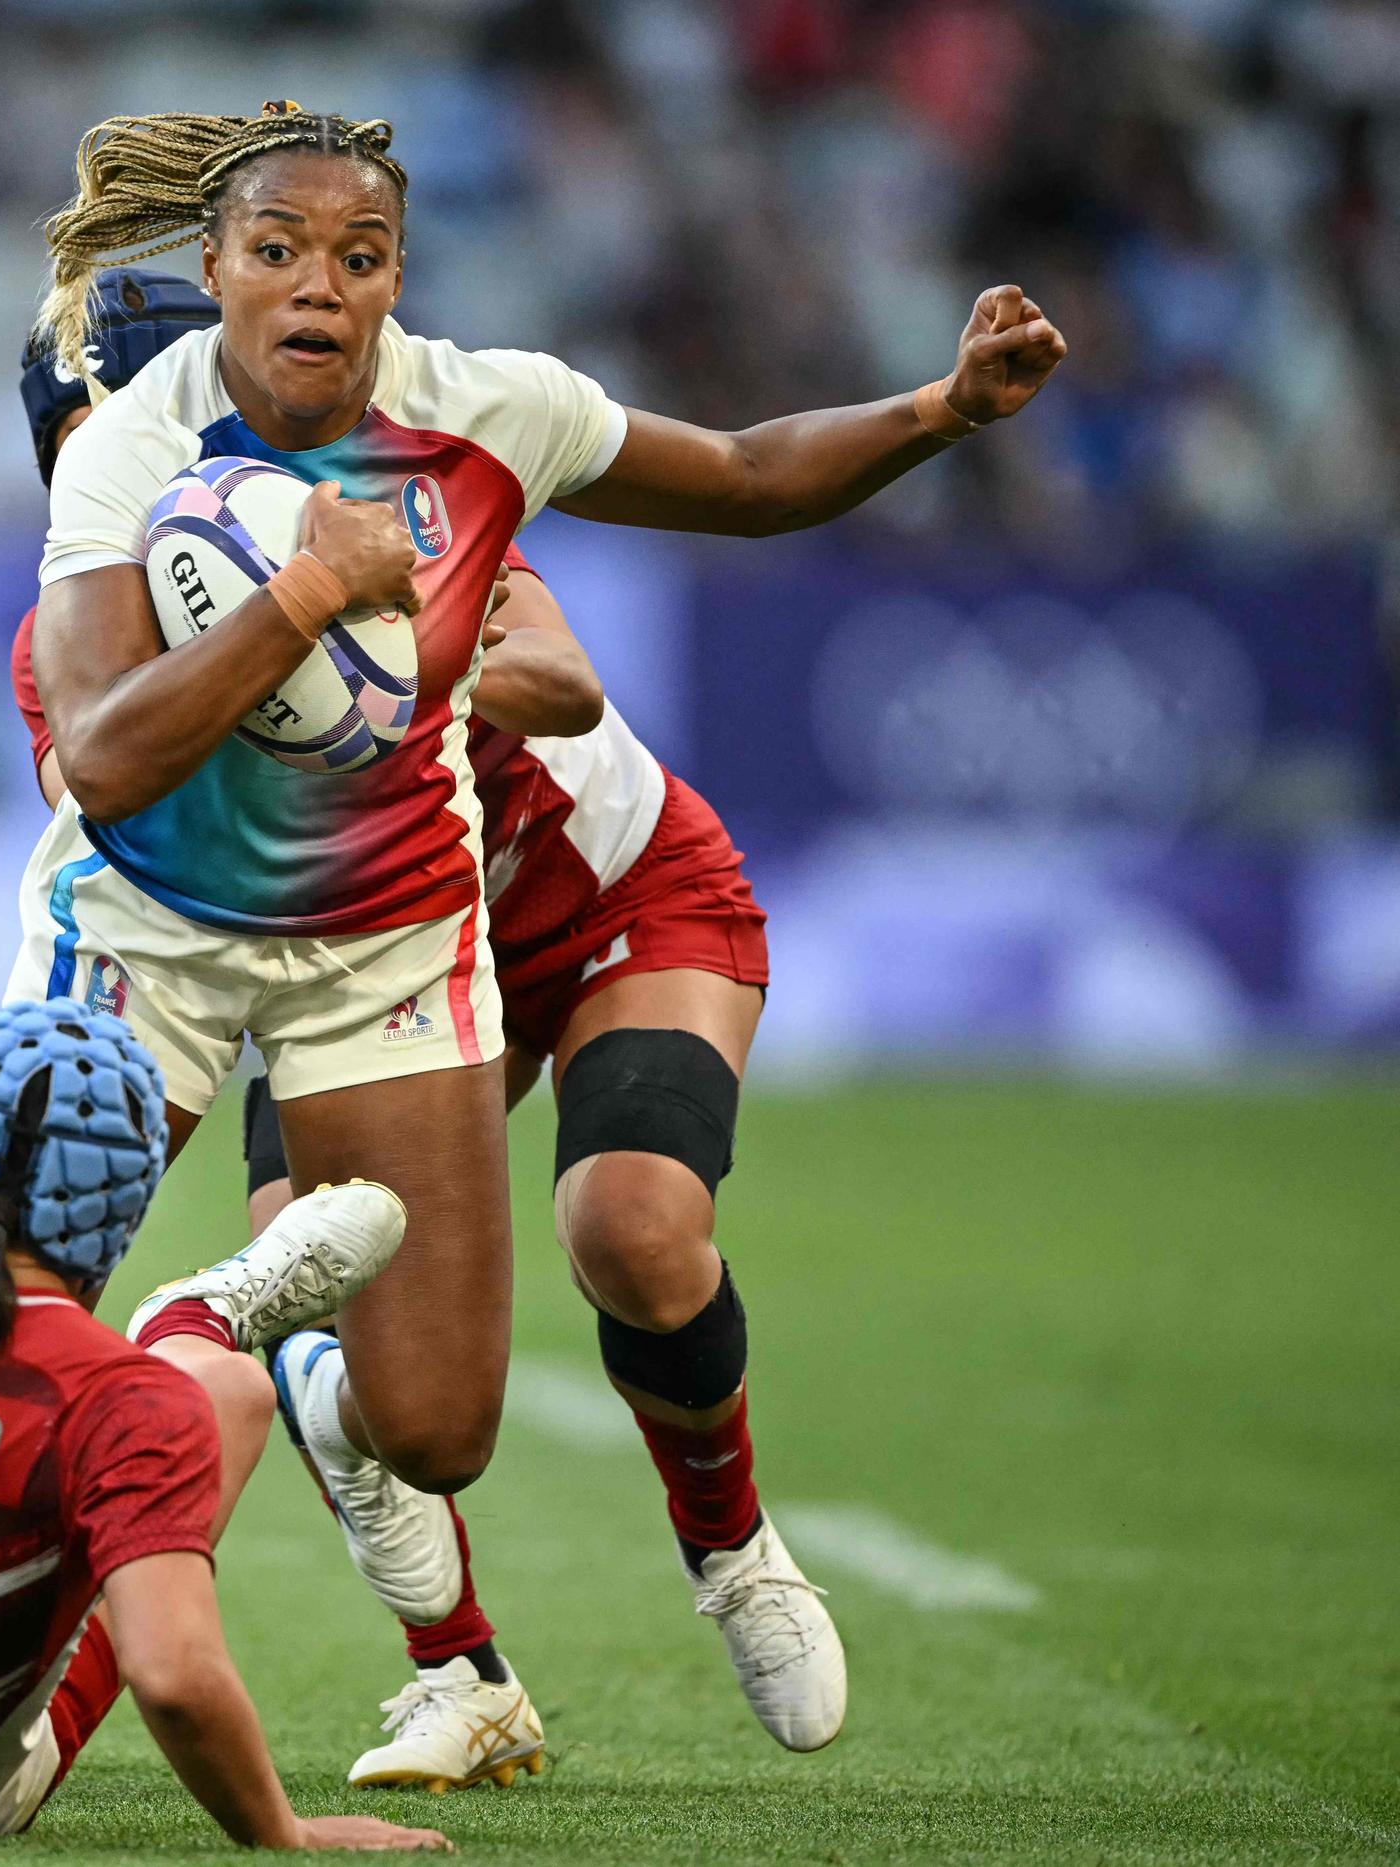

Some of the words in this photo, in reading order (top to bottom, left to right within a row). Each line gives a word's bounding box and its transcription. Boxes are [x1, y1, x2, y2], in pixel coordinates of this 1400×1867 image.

[418, 522, 441, 537] FRANCE
[93, 993, 117, 1008] FRANCE
[383, 1031, 392, 1040] LE
[393, 1028, 407, 1039] COQ
[408, 1024, 435, 1037] SPORTIF
